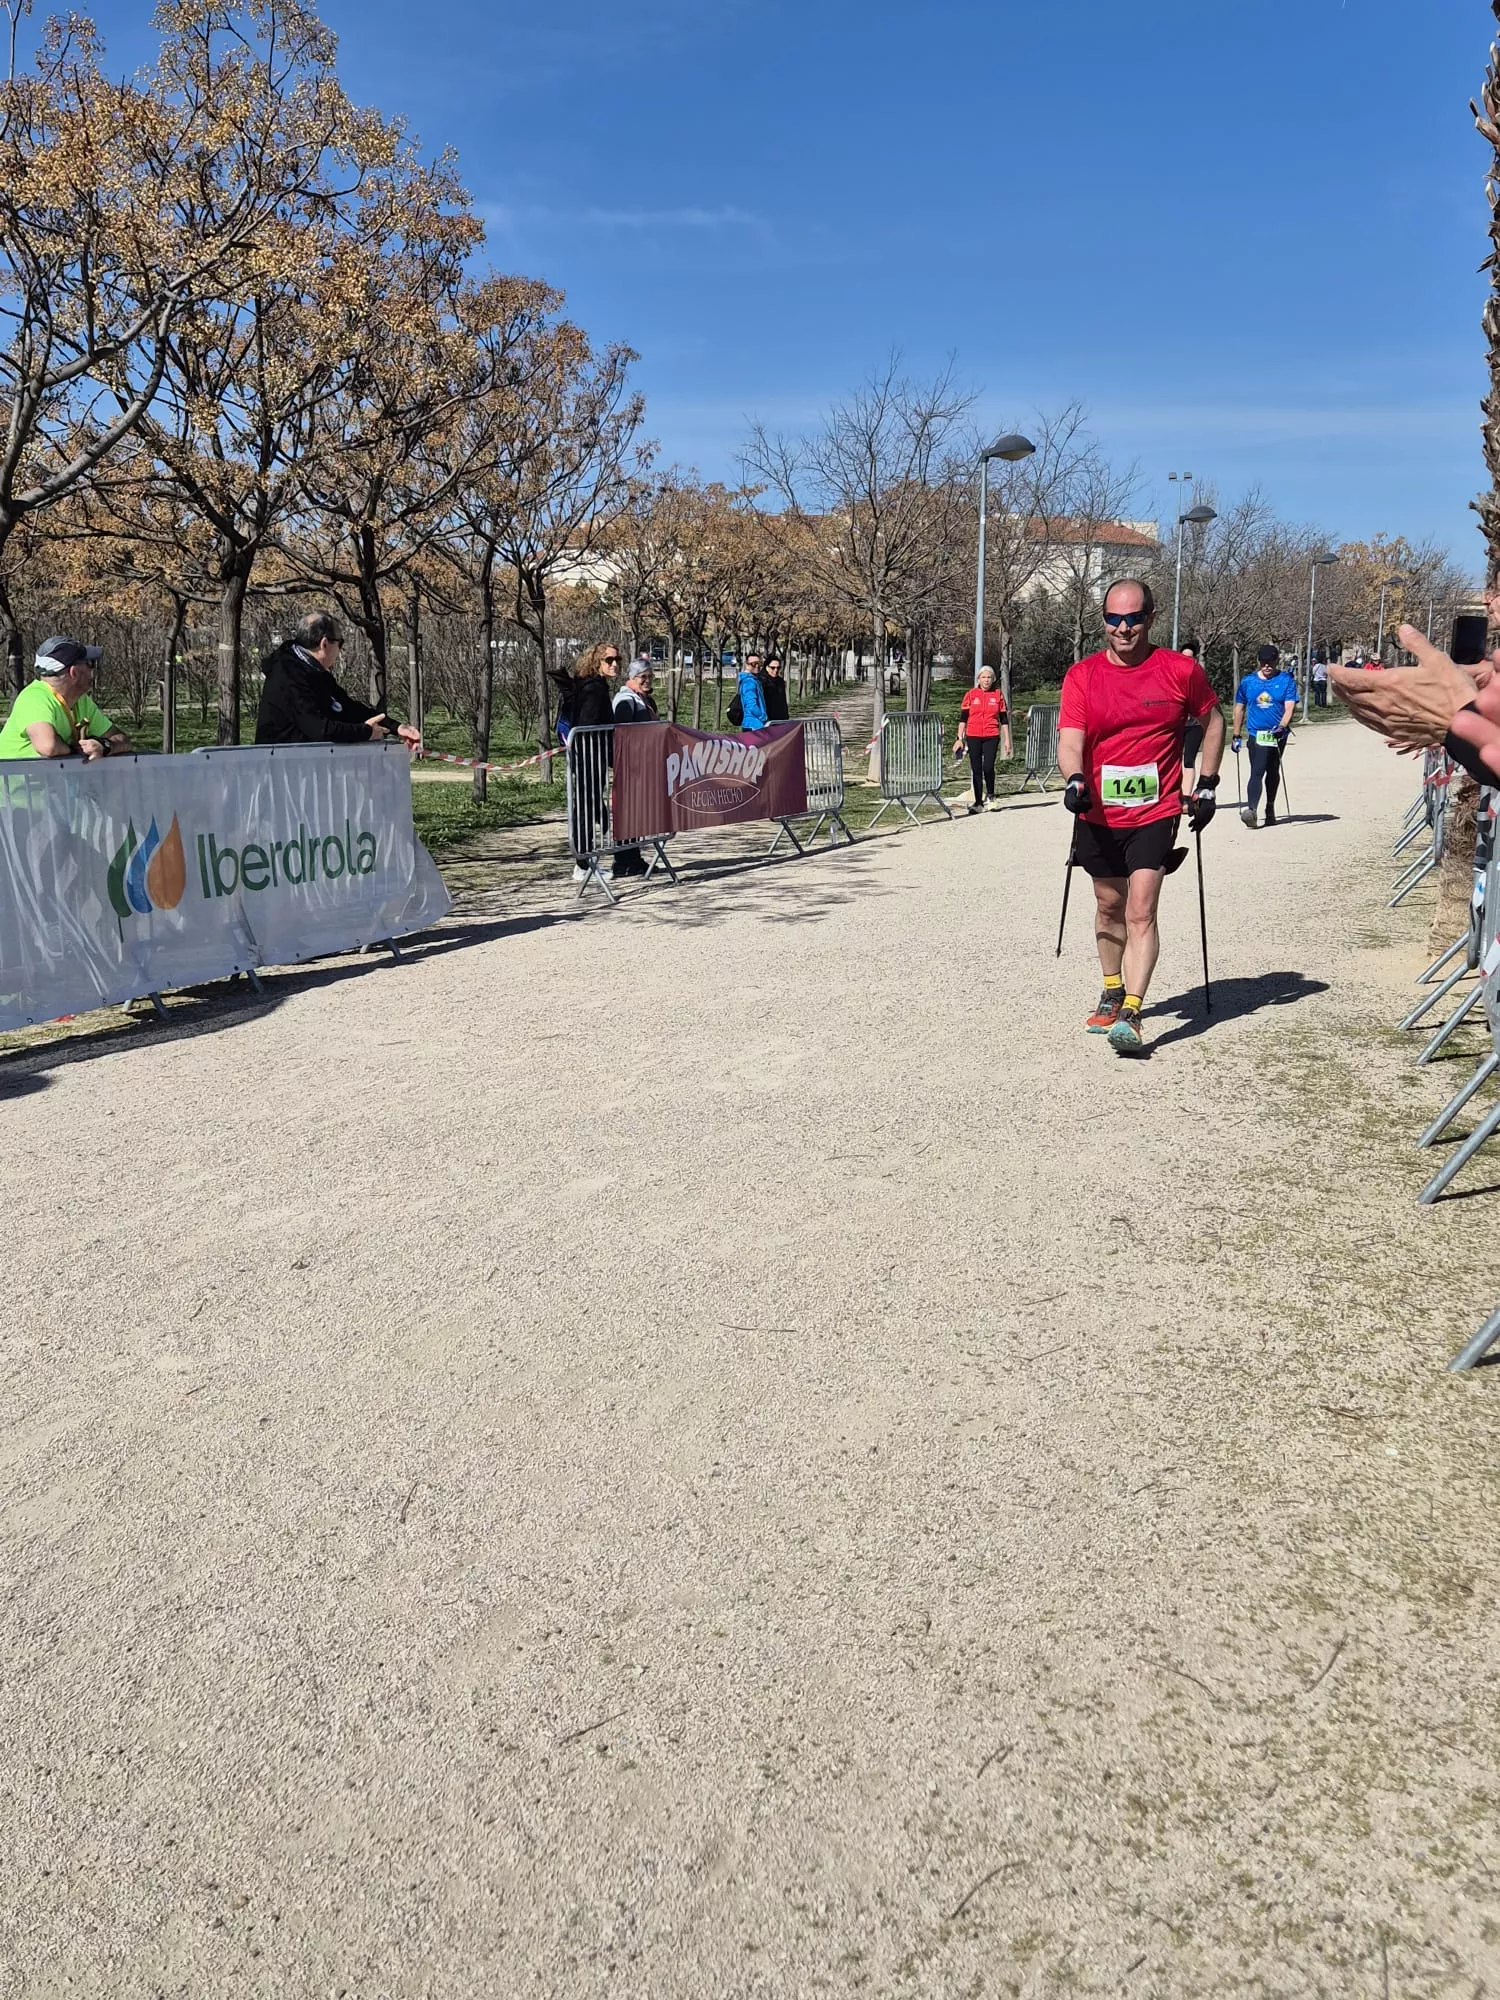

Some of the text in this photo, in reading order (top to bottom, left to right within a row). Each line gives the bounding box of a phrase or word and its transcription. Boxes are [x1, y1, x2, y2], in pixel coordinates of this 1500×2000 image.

[666, 739, 769, 797] PANISHOP
[1113, 777, 1146, 795] 141
[717, 787, 743, 805] HECHO
[197, 818, 377, 899] Iberdrola
